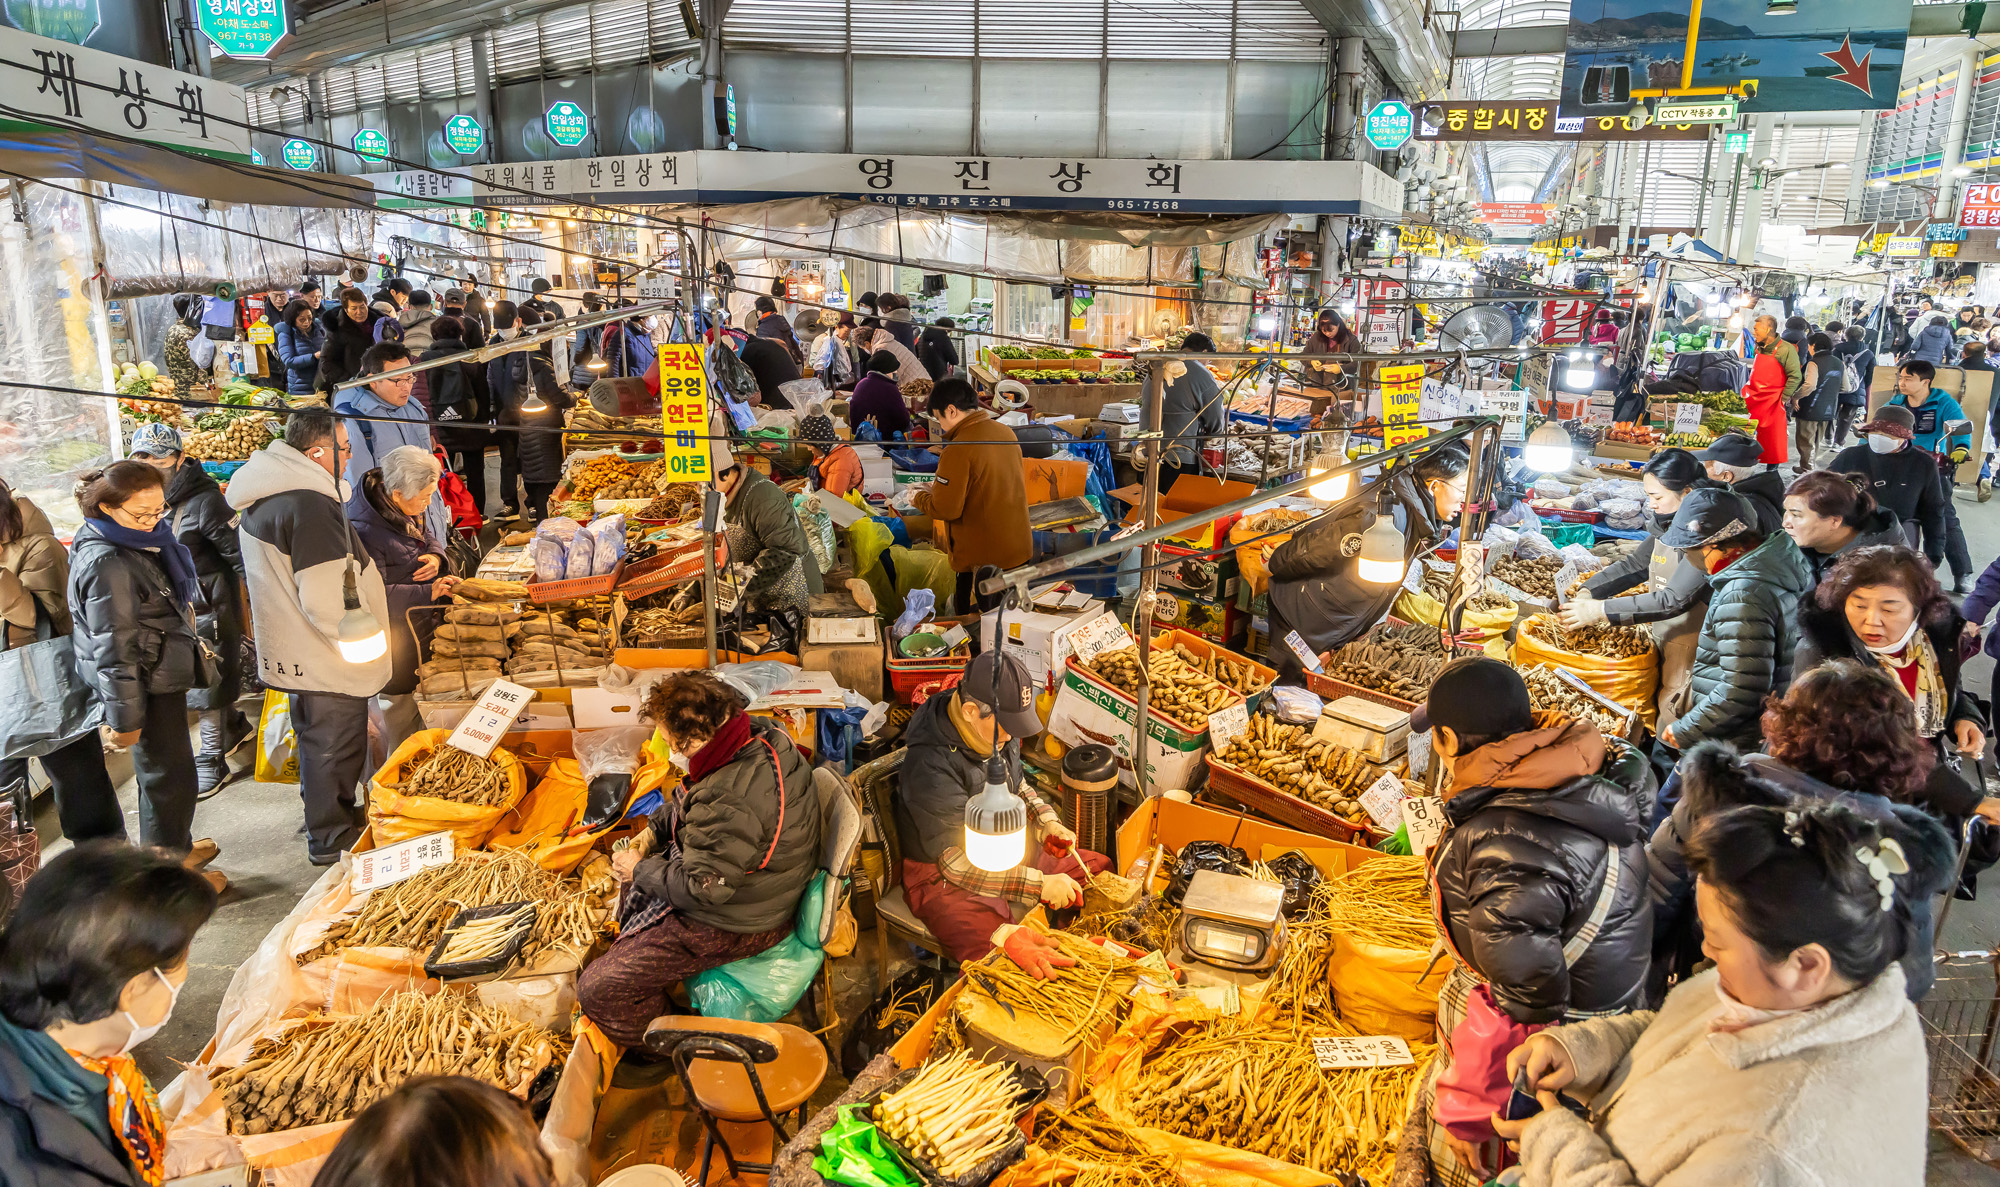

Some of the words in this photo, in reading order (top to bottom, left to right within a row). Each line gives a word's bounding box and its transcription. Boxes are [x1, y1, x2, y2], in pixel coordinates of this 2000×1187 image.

[218, 31, 272, 42] 967-6138
[551, 114, 584, 127] 한일상회
[1370, 115, 1410, 128] 영진식품
[1447, 107, 1548, 131] 종합시장
[1661, 110, 1688, 118] CCTV
[1690, 108, 1714, 118] 작동중
[449, 126, 480, 137] 정원식품
[484, 164, 557, 193] 정원식품
[588, 155, 678, 188] 한일상회
[858, 158, 1183, 194] 영진상회
[404, 172, 453, 197] 나물담다
[876, 195, 898, 205] 오이
[906, 195, 929, 206] 호박
[937, 196, 960, 206] 고추
[664, 350, 700, 371] 국산
[666, 377, 701, 397] 우엉
[1386, 372, 1420, 392] 국산
[1389, 393, 1420, 406] 100%
[1499, 401, 1520, 411] 우엉
[667, 404, 703, 424] 연근
[1388, 412, 1423, 431] 연근
[670, 455, 706, 474] 야콘
[494, 688, 519, 703] 강원도
[1076, 682, 1112, 710] 소백산
[485, 701, 510, 717] 도라지
[399, 848, 411, 873] 도라지
